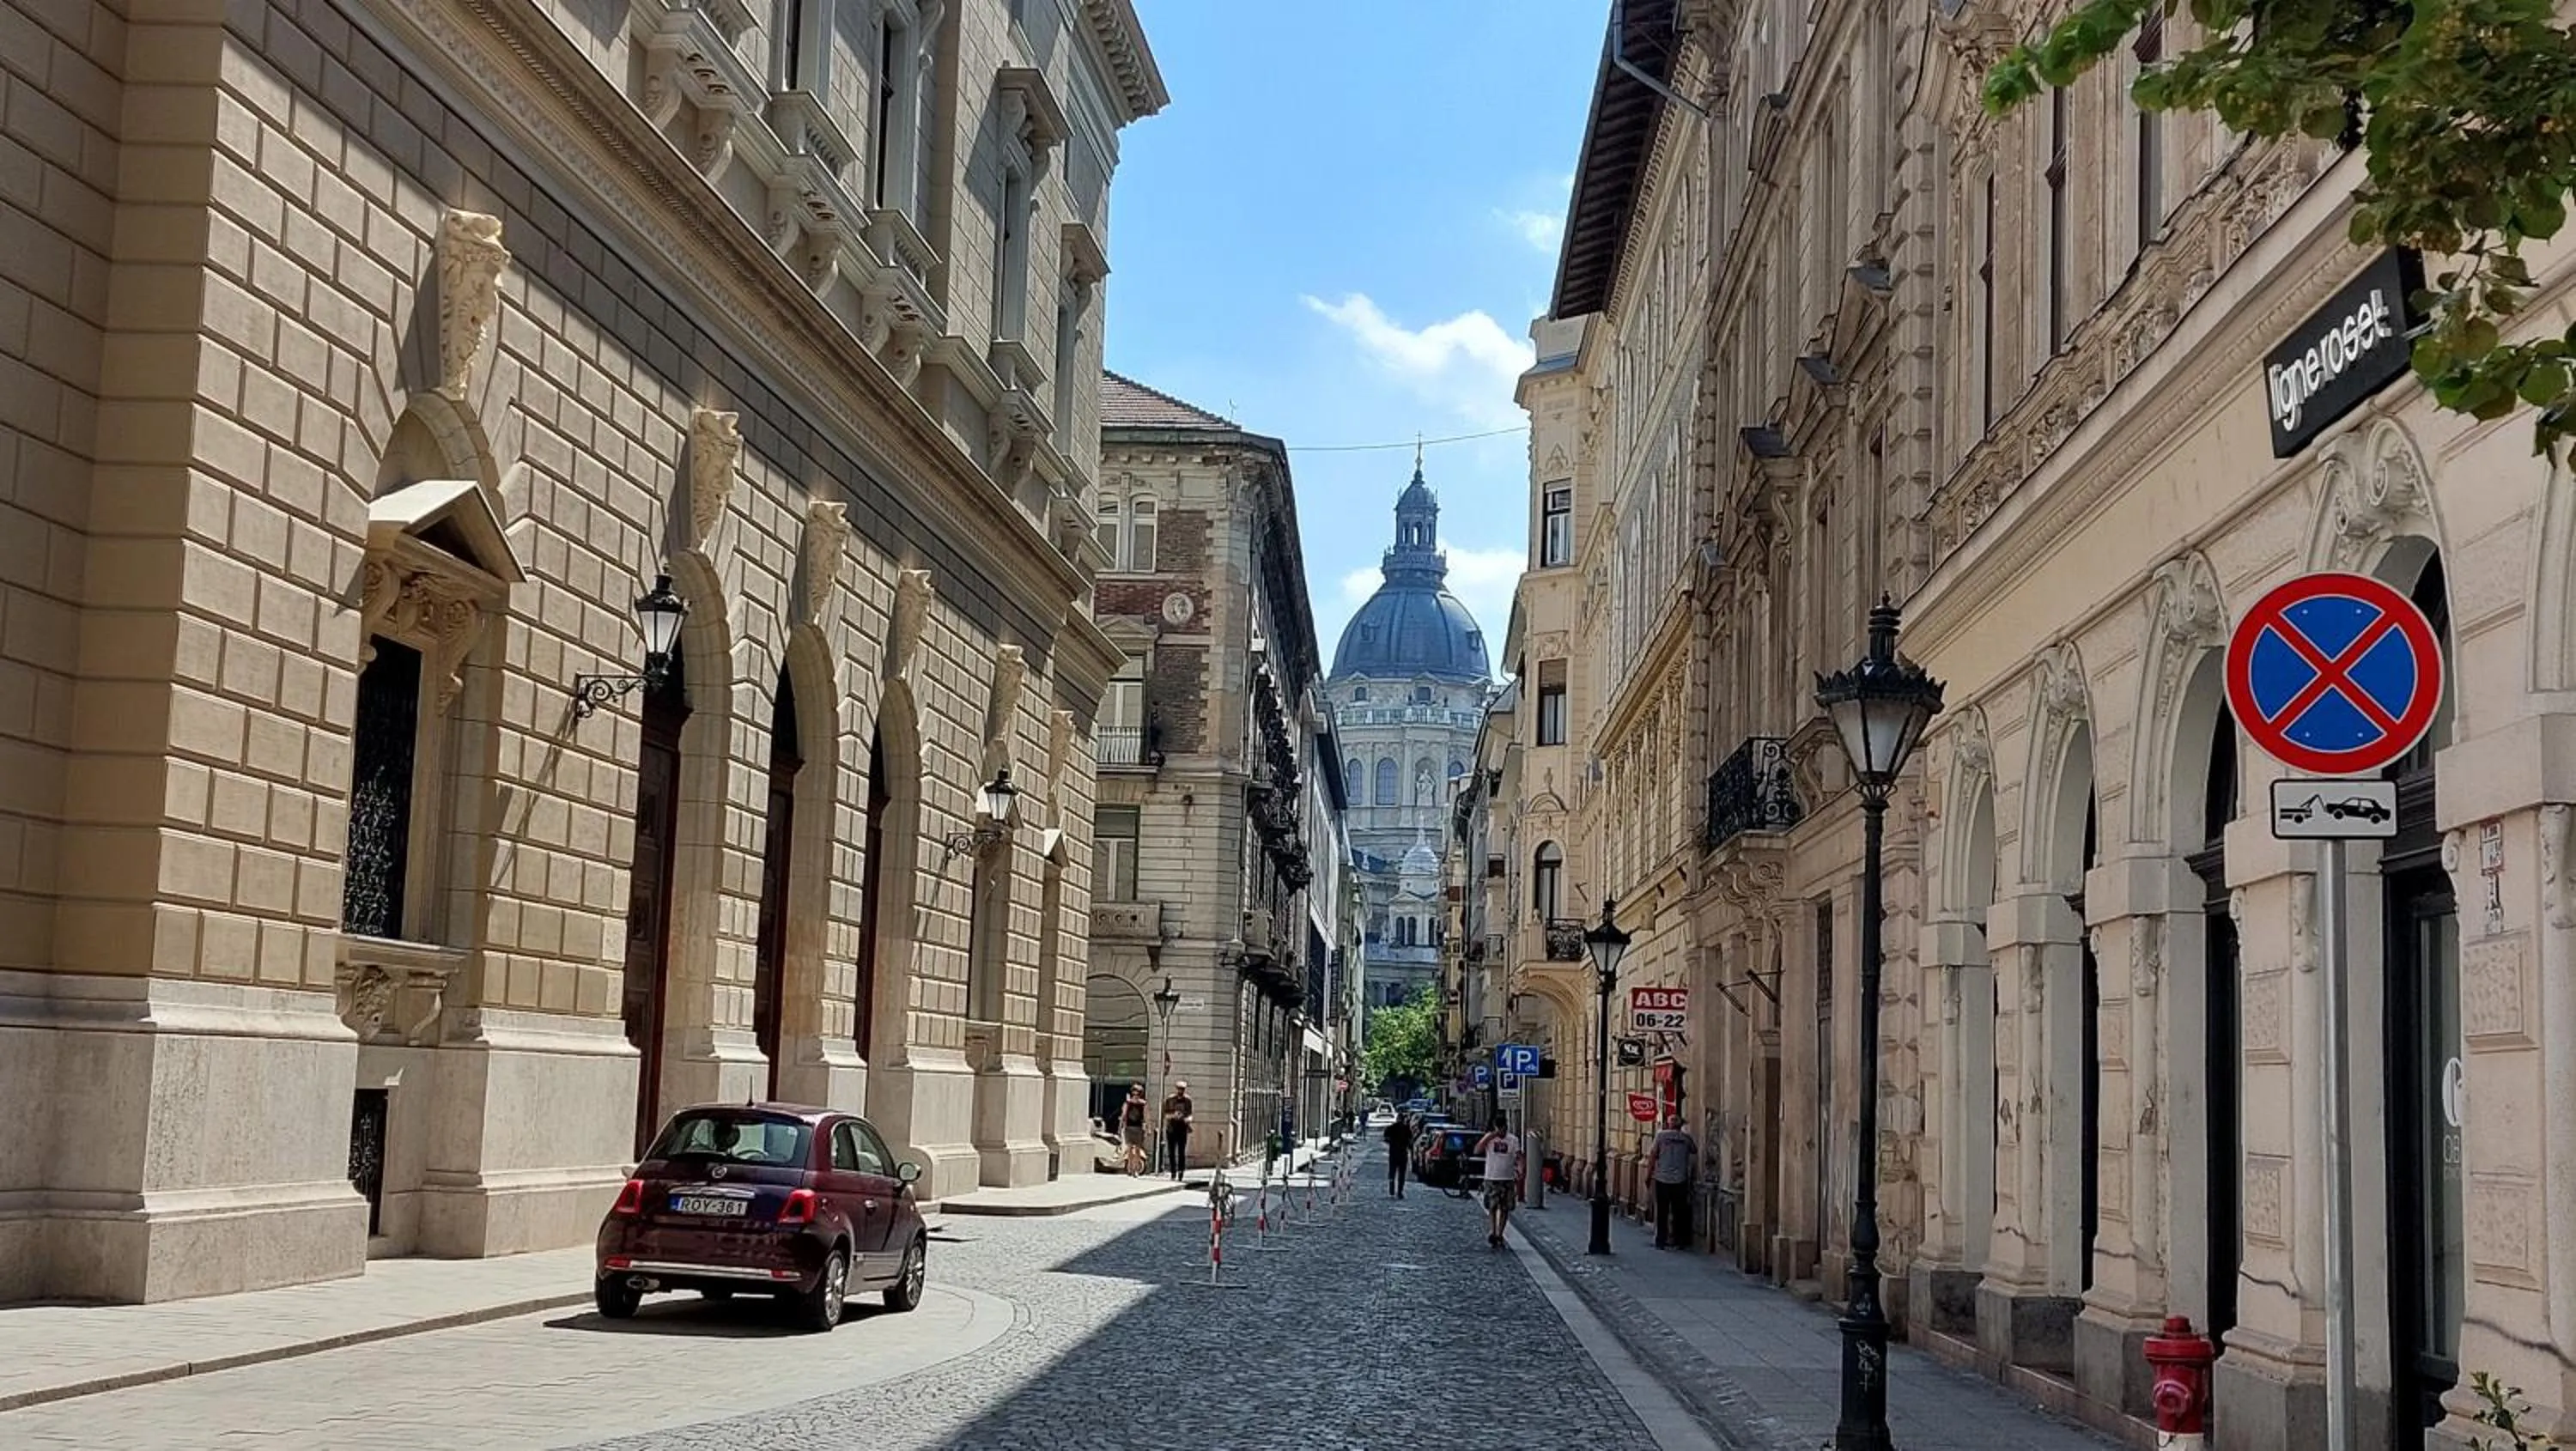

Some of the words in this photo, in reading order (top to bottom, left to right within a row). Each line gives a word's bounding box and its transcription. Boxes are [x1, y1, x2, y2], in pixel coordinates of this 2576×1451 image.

[1635, 991, 1686, 1008] ABC
[1636, 1013, 1685, 1029] 06-22
[1516, 1050, 1532, 1072] P
[1474, 1065, 1488, 1083] P
[1504, 1072, 1514, 1088] P
[681, 1197, 743, 1213] ROY-361
